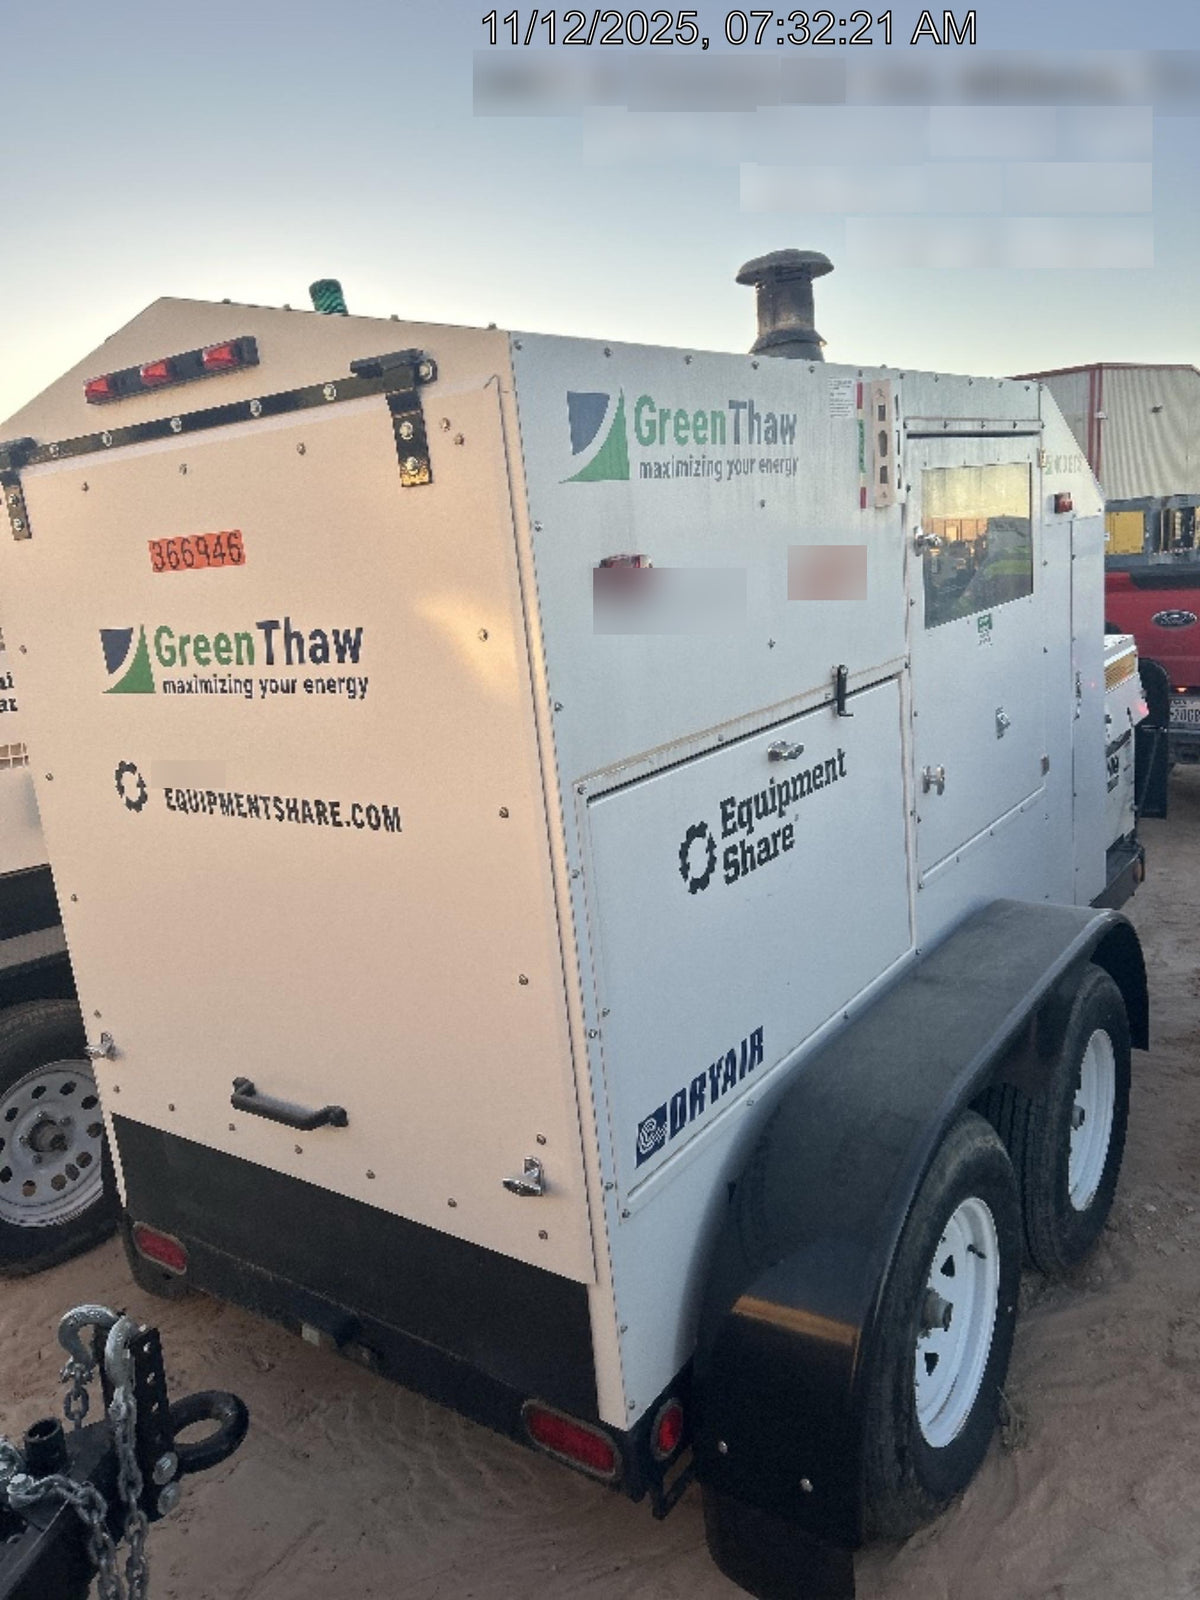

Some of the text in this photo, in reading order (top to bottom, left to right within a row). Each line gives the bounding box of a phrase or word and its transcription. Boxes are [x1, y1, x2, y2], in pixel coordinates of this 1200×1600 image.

[634, 394, 797, 447] GreenThaw
[639, 454, 799, 482] maximizing your energy
[152, 532, 241, 570] 366946
[154, 616, 363, 667] GreenThaw
[162, 673, 369, 700] maximizing your energy
[163, 787, 402, 832] EQUIPMENTSHARE.COM
[720, 748, 847, 839] Equipment
[723, 823, 795, 885] Share
[669, 1025, 764, 1140] DRYAIR
